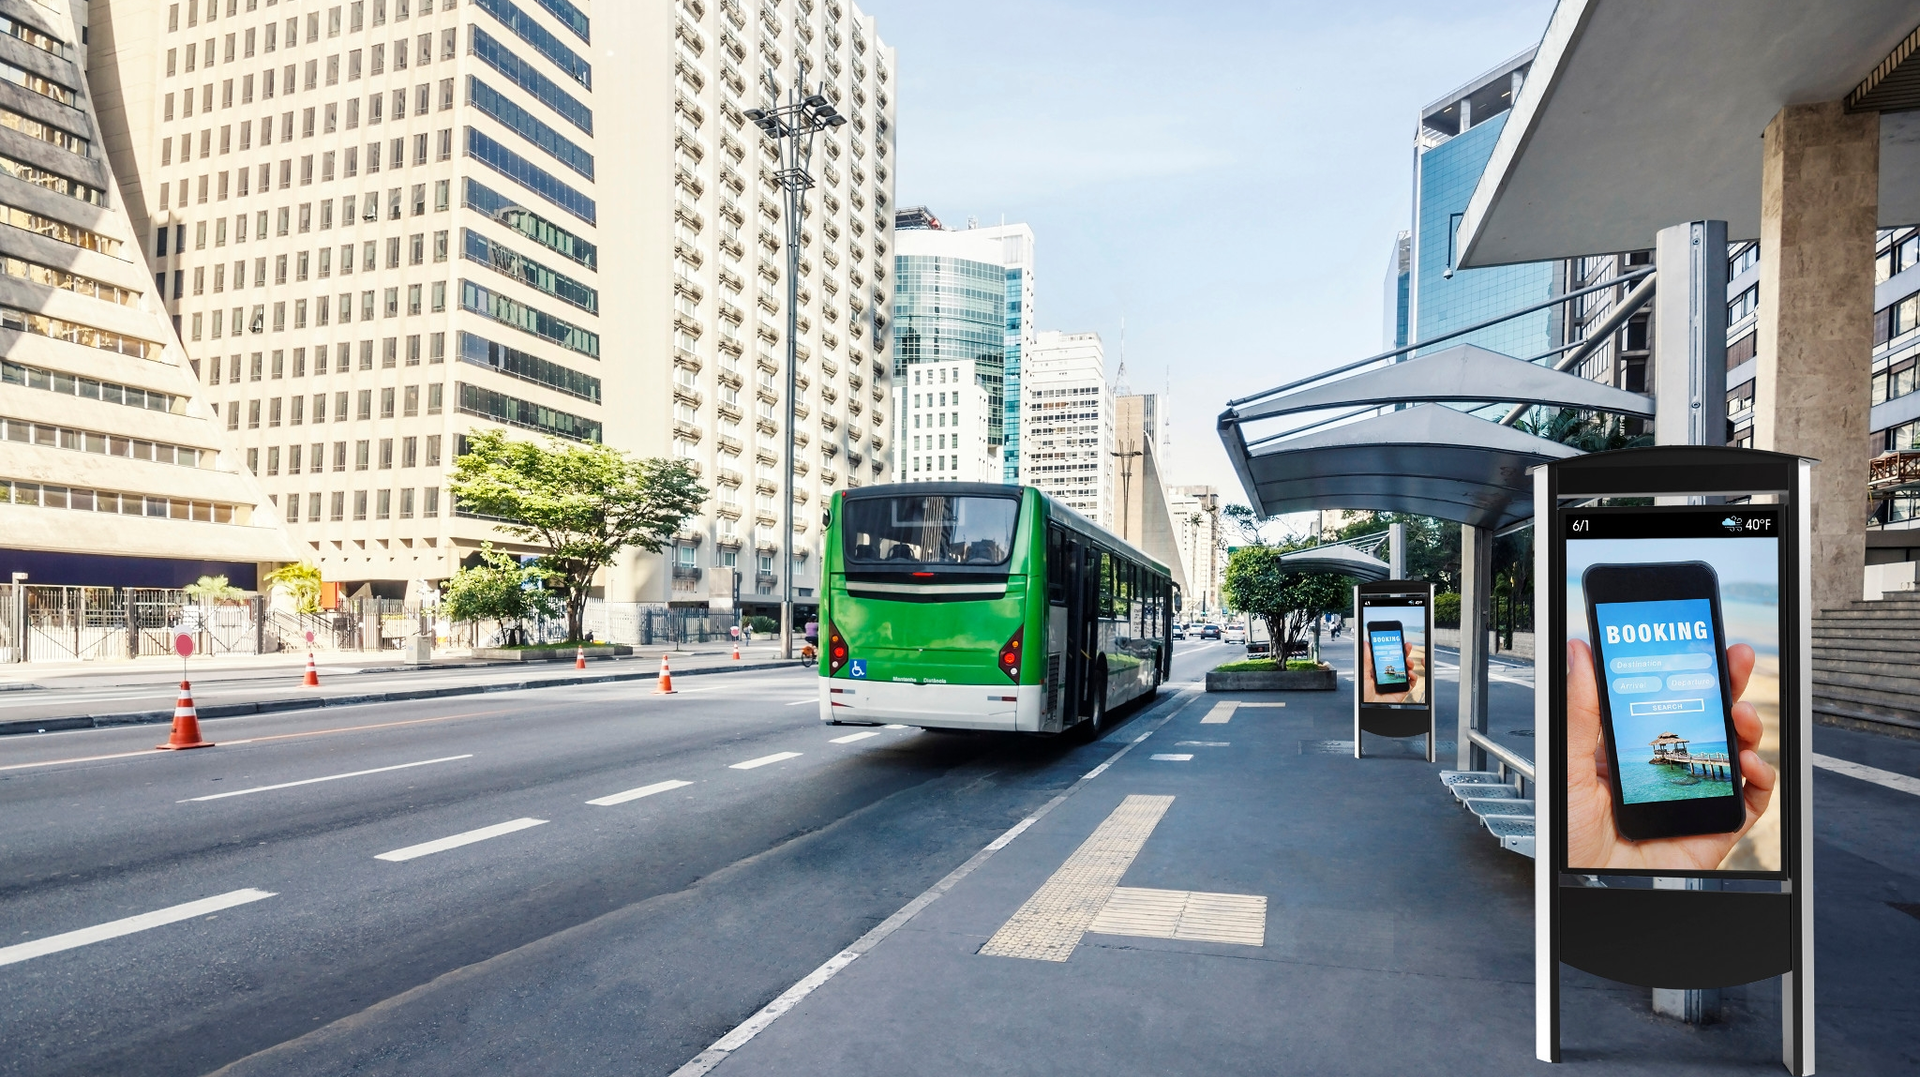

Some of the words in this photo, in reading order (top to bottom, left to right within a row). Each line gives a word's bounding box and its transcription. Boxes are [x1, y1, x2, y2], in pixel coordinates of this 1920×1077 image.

[1572, 519, 1589, 532] 6/1
[1745, 518, 1771, 531] 40°F
[1606, 621, 1708, 644] BOOKING
[1373, 635, 1400, 643] BOOKING
[1617, 660, 1662, 669] Destination
[1620, 681, 1647, 690] Arrival
[1671, 679, 1710, 687] Departure
[1652, 703, 1683, 711] SEARCH
